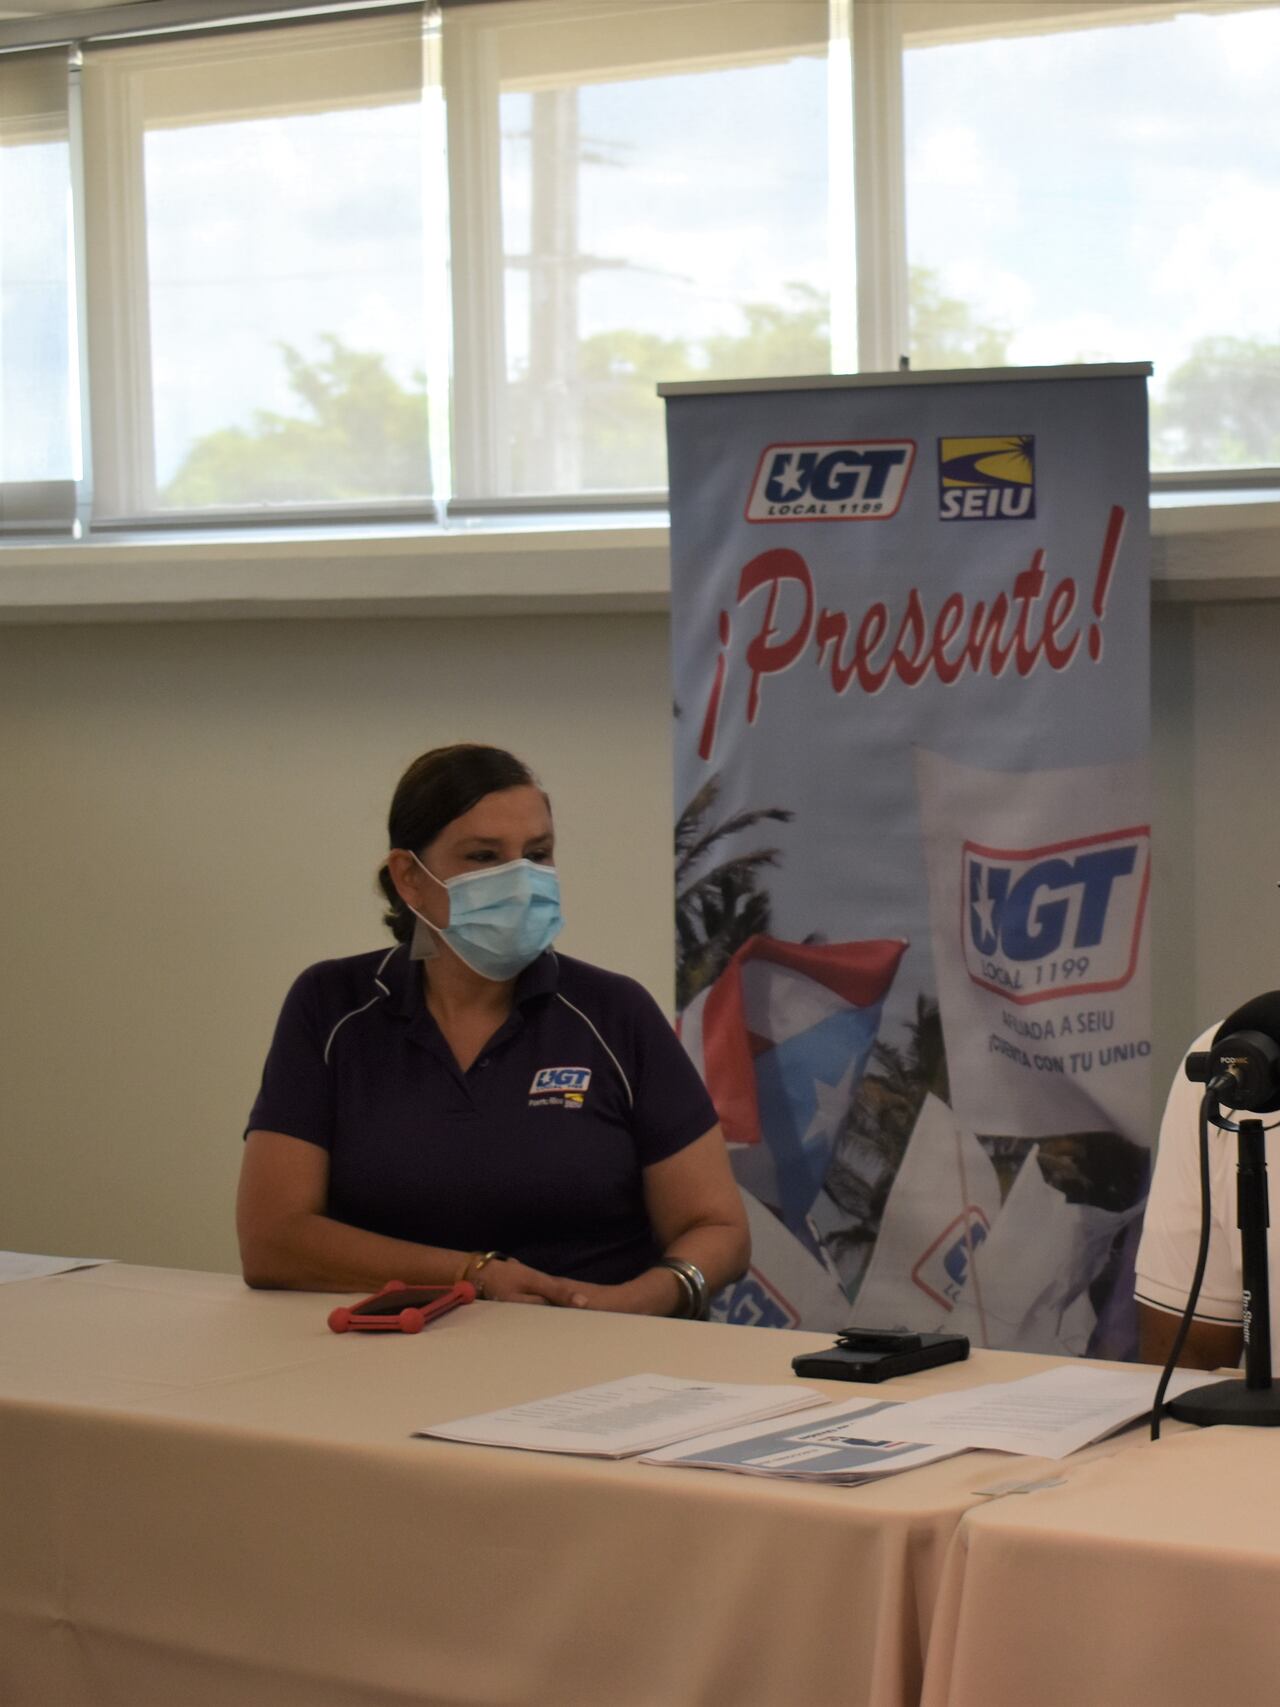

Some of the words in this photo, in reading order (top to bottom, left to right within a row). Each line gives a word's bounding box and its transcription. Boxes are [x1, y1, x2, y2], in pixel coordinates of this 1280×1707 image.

[763, 449, 906, 503] UGT
[768, 502, 828, 515] LOCAL
[838, 501, 883, 514] 1199
[940, 487, 1034, 519] SEIU
[969, 844, 1138, 962] UGT
[980, 958, 1025, 990] LOCAL
[1035, 956, 1090, 985] 1199
[1060, 1015, 1073, 1037] A
[1077, 1010, 1115, 1034] SEIU
[1033, 1053, 1065, 1074] CON
[1069, 1050, 1093, 1074] TU
[536, 1069, 592, 1088] UGT
